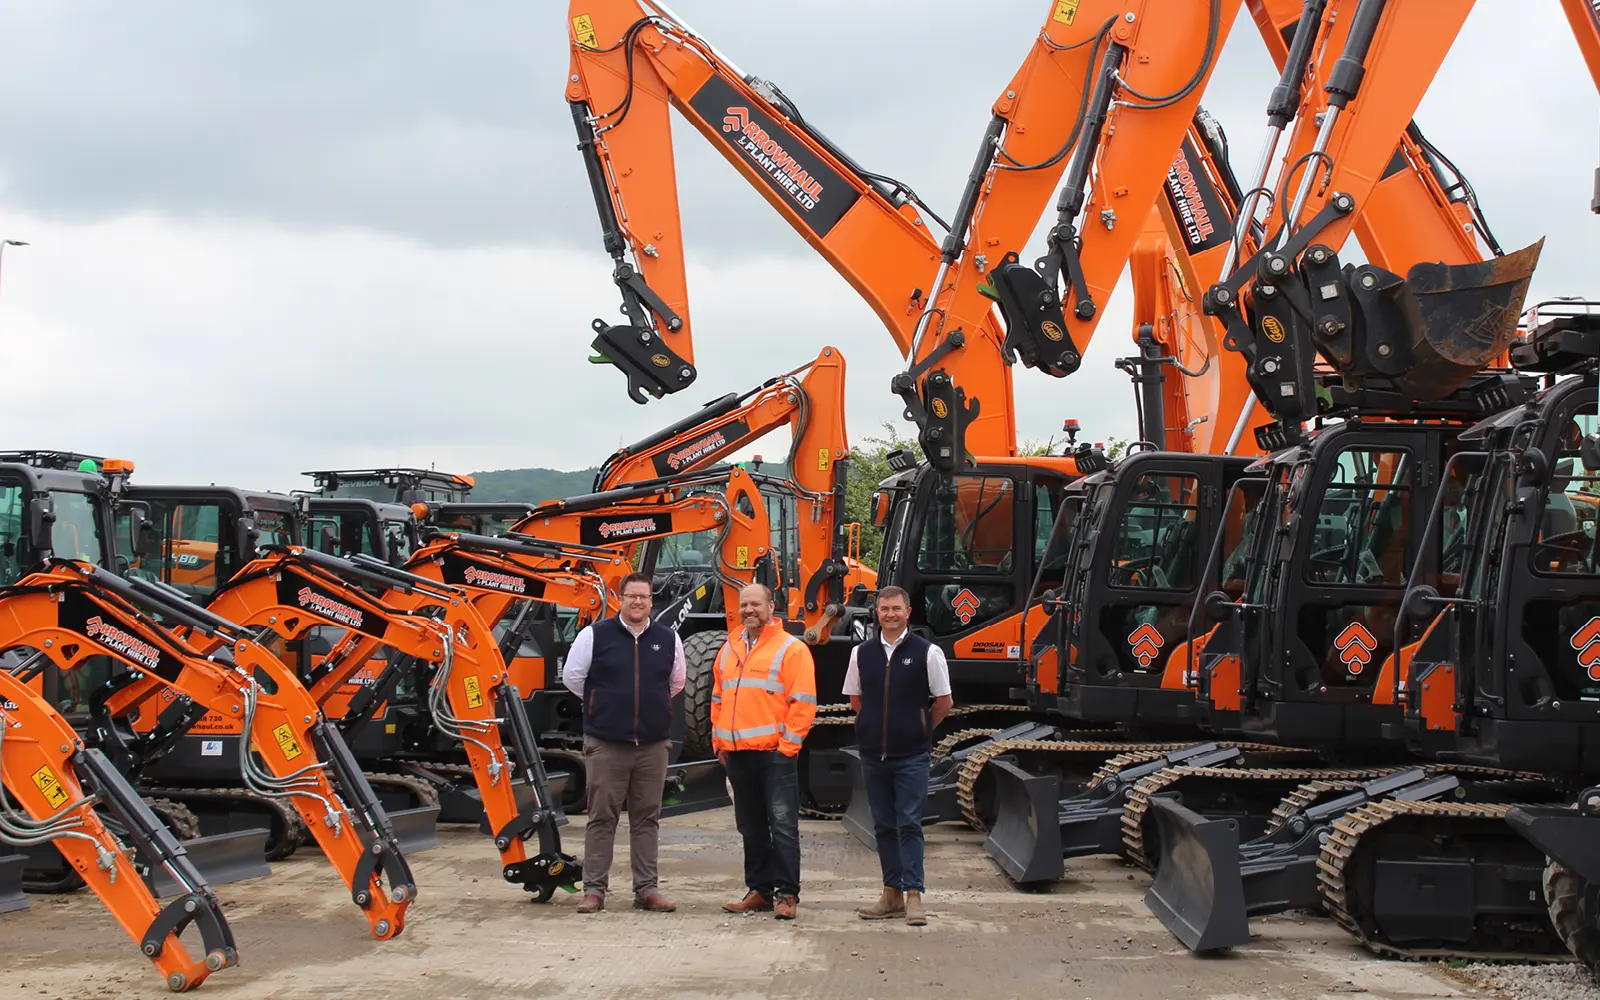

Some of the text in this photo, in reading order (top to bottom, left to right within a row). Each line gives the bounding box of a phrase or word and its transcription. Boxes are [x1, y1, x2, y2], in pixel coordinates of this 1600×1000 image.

[744, 142, 777, 172] PLANT
[773, 169, 799, 195] HIRE
[795, 191, 815, 210] LTD
[1177, 199, 1193, 225] HIRE
[1187, 225, 1201, 244] LTD
[715, 438, 726, 447] LTD
[481, 579, 500, 588] PLANT
[514, 585, 525, 593] LTD
[316, 605, 334, 617] PLANT
[334, 612, 350, 623] HIRE
[349, 619, 362, 627] LTD
[105, 636, 127, 653] PLANT
[126, 648, 145, 662] HIRE
[144, 657, 158, 669] LTD
